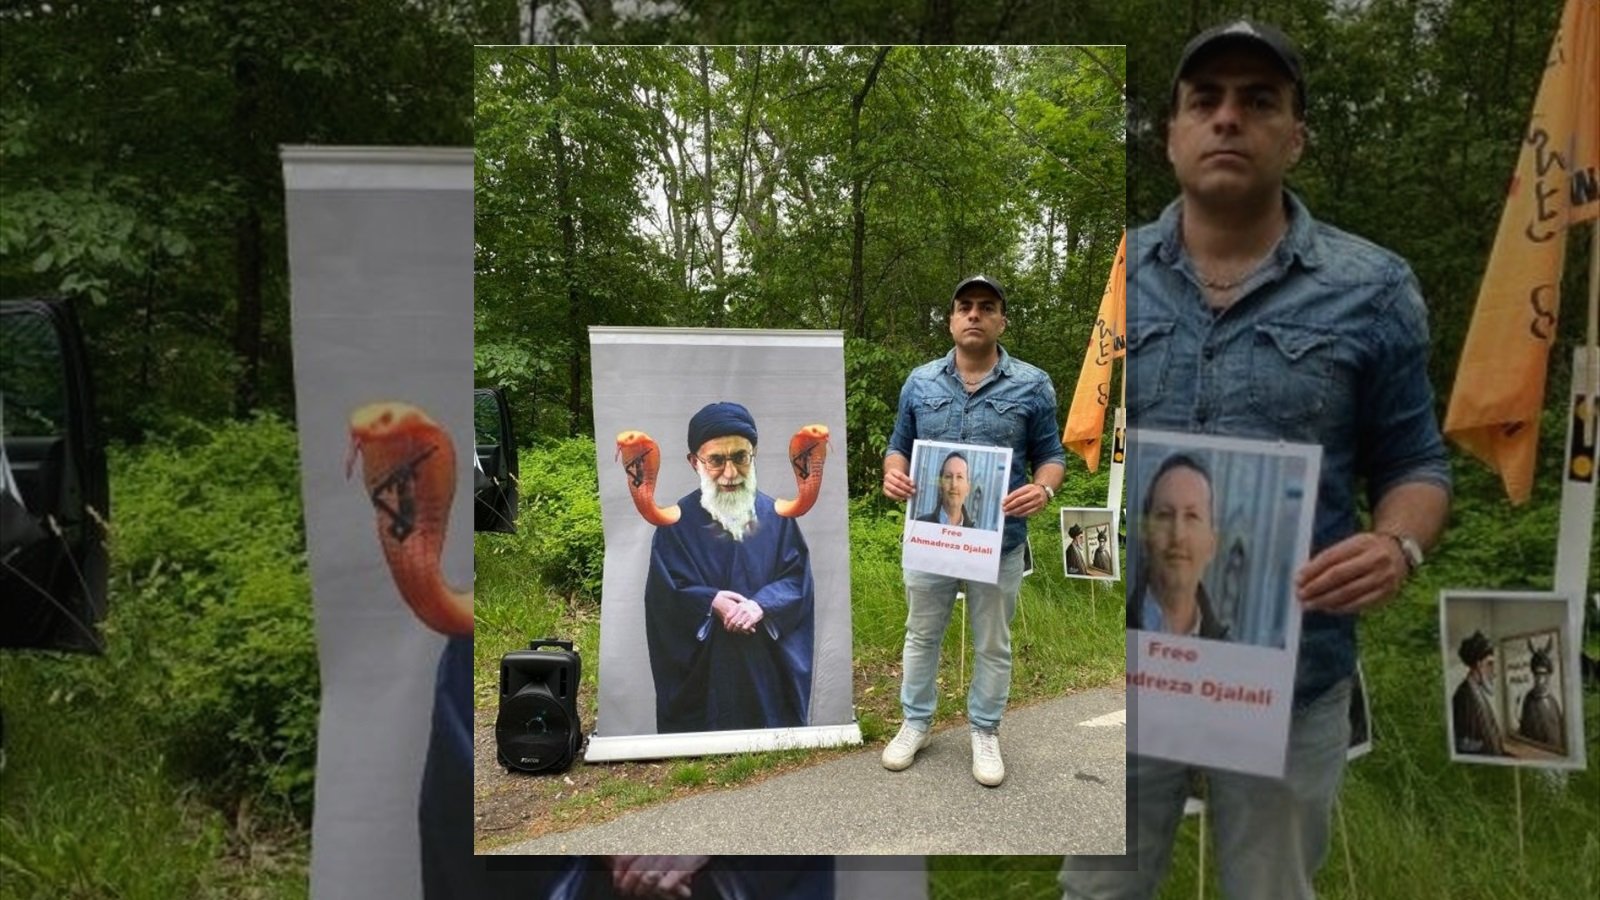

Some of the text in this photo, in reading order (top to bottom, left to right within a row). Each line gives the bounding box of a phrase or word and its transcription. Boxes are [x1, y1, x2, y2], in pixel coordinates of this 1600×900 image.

[941, 528, 962, 537] Free
[910, 536, 993, 555] Ahmadreza Djalali
[1148, 641, 1198, 662] Free
[1200, 681, 1272, 706] Djalali
